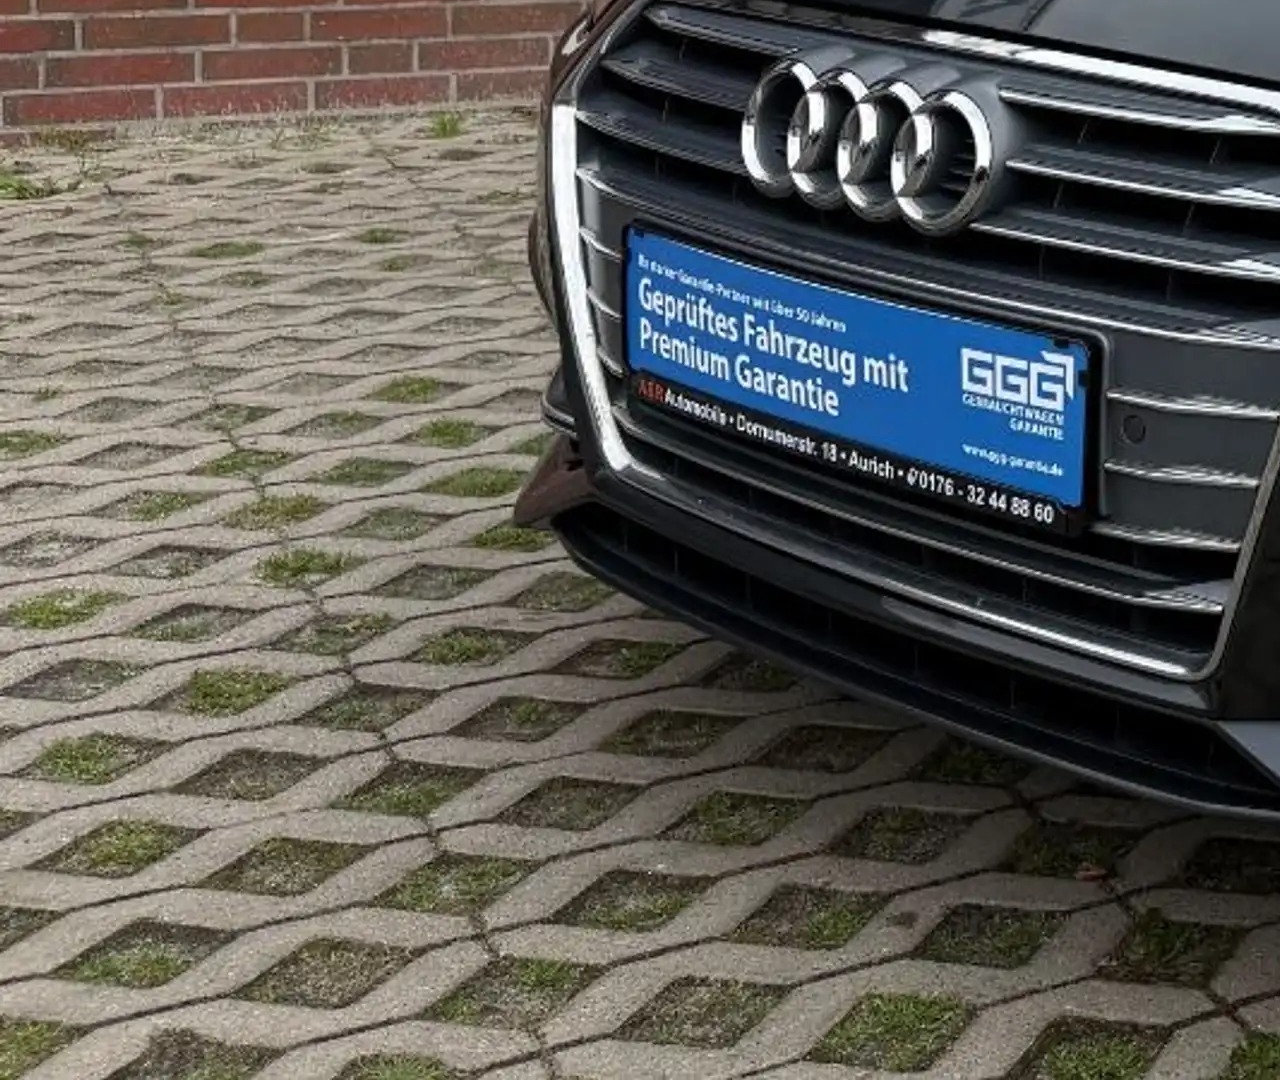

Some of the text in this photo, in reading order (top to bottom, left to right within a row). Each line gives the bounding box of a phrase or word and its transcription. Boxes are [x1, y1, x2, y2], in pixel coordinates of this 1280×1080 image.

[638, 277, 909, 393] Geprüftes Fahrzeug mit
[796, 306, 810, 323] 50
[640, 317, 839, 416] Premium Garantie
[960, 347, 1066, 412] GGG
[736, 413, 818, 457] Dornumerstr.
[821, 443, 838, 462] 18
[849, 450, 894, 480] Aurich
[967, 484, 985, 506] 32
[988, 491, 1007, 512] 44
[1010, 496, 1031, 518] 88
[1034, 502, 1055, 524] 60
